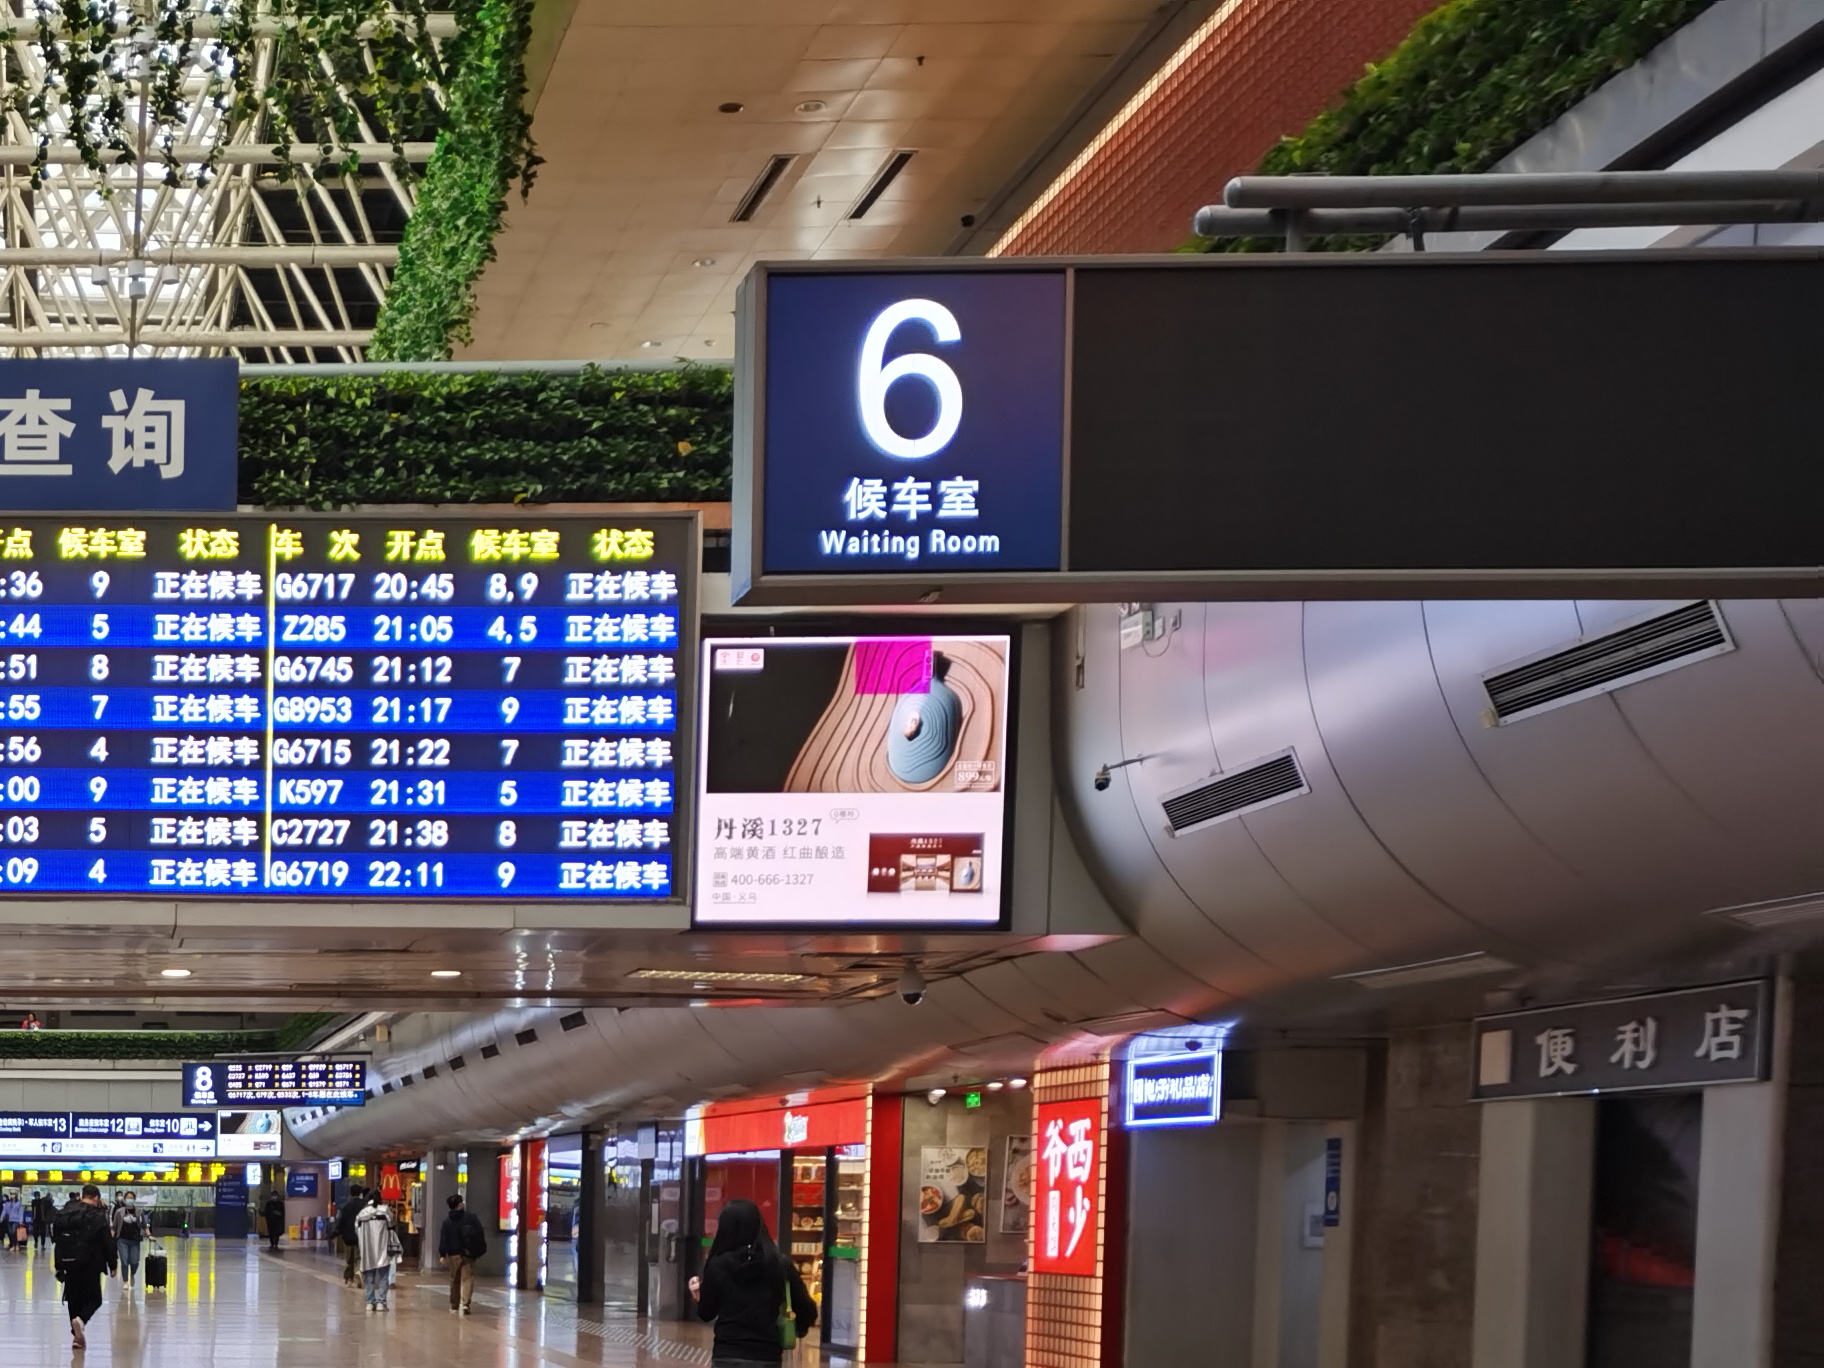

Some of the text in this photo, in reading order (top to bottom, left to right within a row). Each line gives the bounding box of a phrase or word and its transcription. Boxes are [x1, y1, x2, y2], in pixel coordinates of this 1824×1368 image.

[859, 298, 963, 459] 6
[845, 476, 979, 520] 候车室
[57, 528, 146, 559] 候车室
[179, 529, 239, 559] 状态
[386, 530, 445, 561] 开点
[470, 529, 559, 561] 候车室
[594, 529, 654, 561] 状态
[819, 529, 1000, 559] Waiting Room
[92, 571, 109, 598] 9
[153, 570, 263, 600] 正在候车
[276, 573, 355, 600] G6717
[374, 573, 454, 600] 20:45
[566, 571, 677, 601] 正在候车
[92, 614, 109, 639] 5
[153, 612, 262, 642] 正在候车
[282, 615, 346, 642] Z285
[374, 615, 453, 642] 21:05
[565, 613, 676, 643] 正在候车
[91, 654, 108, 680] 8
[153, 654, 261, 682] 正在候车
[273, 654, 675, 684] G6745 21:12 7 正在候车
[273, 697, 451, 723] G8953 21:17
[273, 739, 450, 765] G6715 21:22
[279, 779, 444, 806] K597 21:31
[272, 819, 448, 846] C2727 21:38
[271, 861, 443, 887] G6719 22:11
[730, 873, 814, 885] 400-666-1327
[1534, 1003, 1752, 1078] 便利店
[195, 1065, 213, 1091] 8
[53, 1118, 67, 1132] 13
[110, 1118, 124, 1132] 12
[165, 1118, 180, 1133] 10
